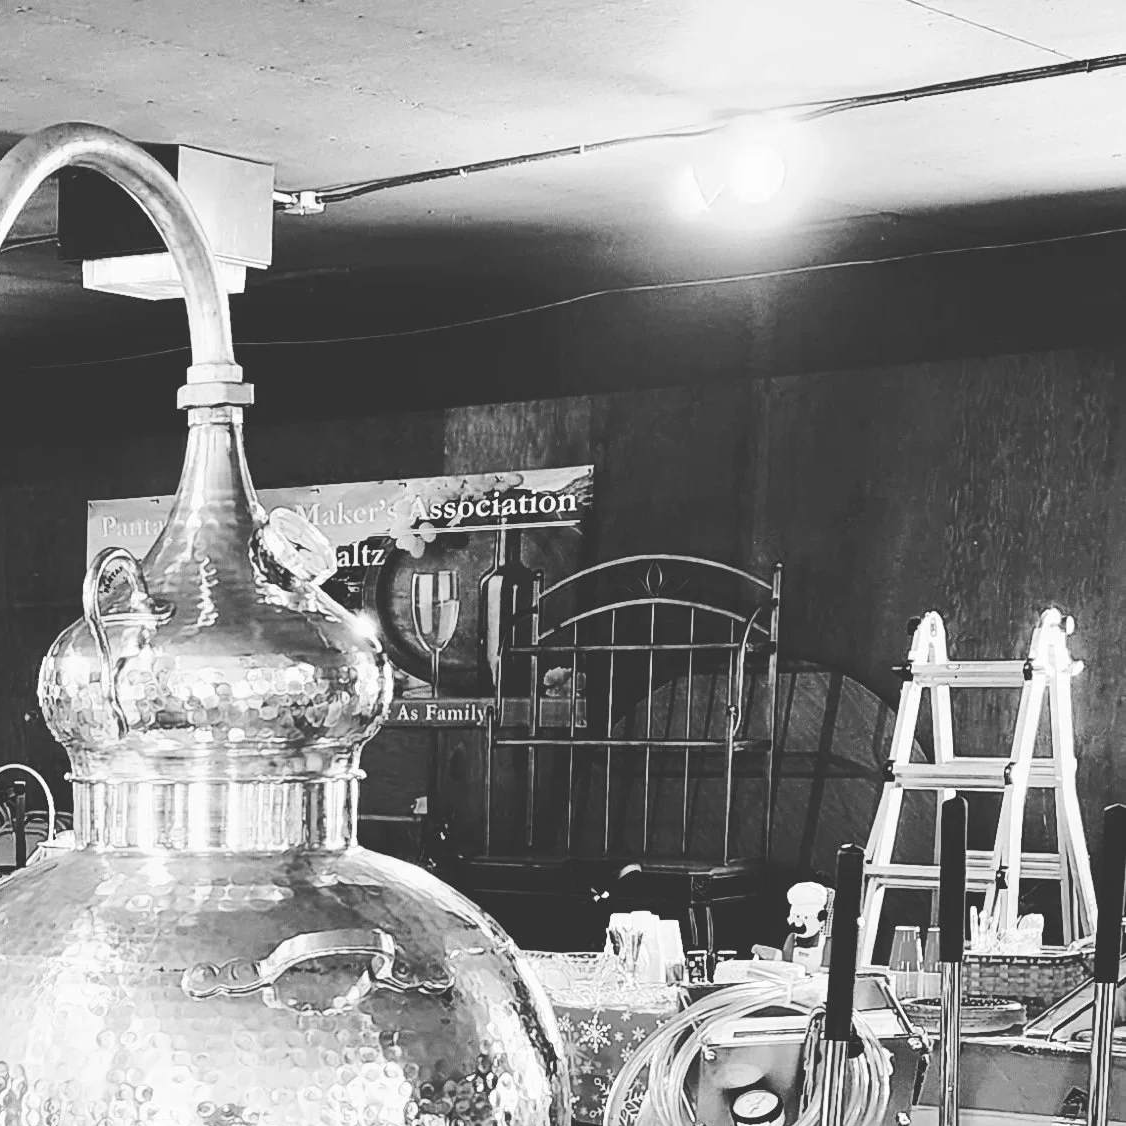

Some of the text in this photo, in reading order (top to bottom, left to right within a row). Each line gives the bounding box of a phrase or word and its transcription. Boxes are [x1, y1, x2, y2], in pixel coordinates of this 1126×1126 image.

[294, 499, 399, 526] Maker's
[409, 490, 578, 521] Association
[396, 704, 419, 721] As
[425, 704, 485, 726] Family
